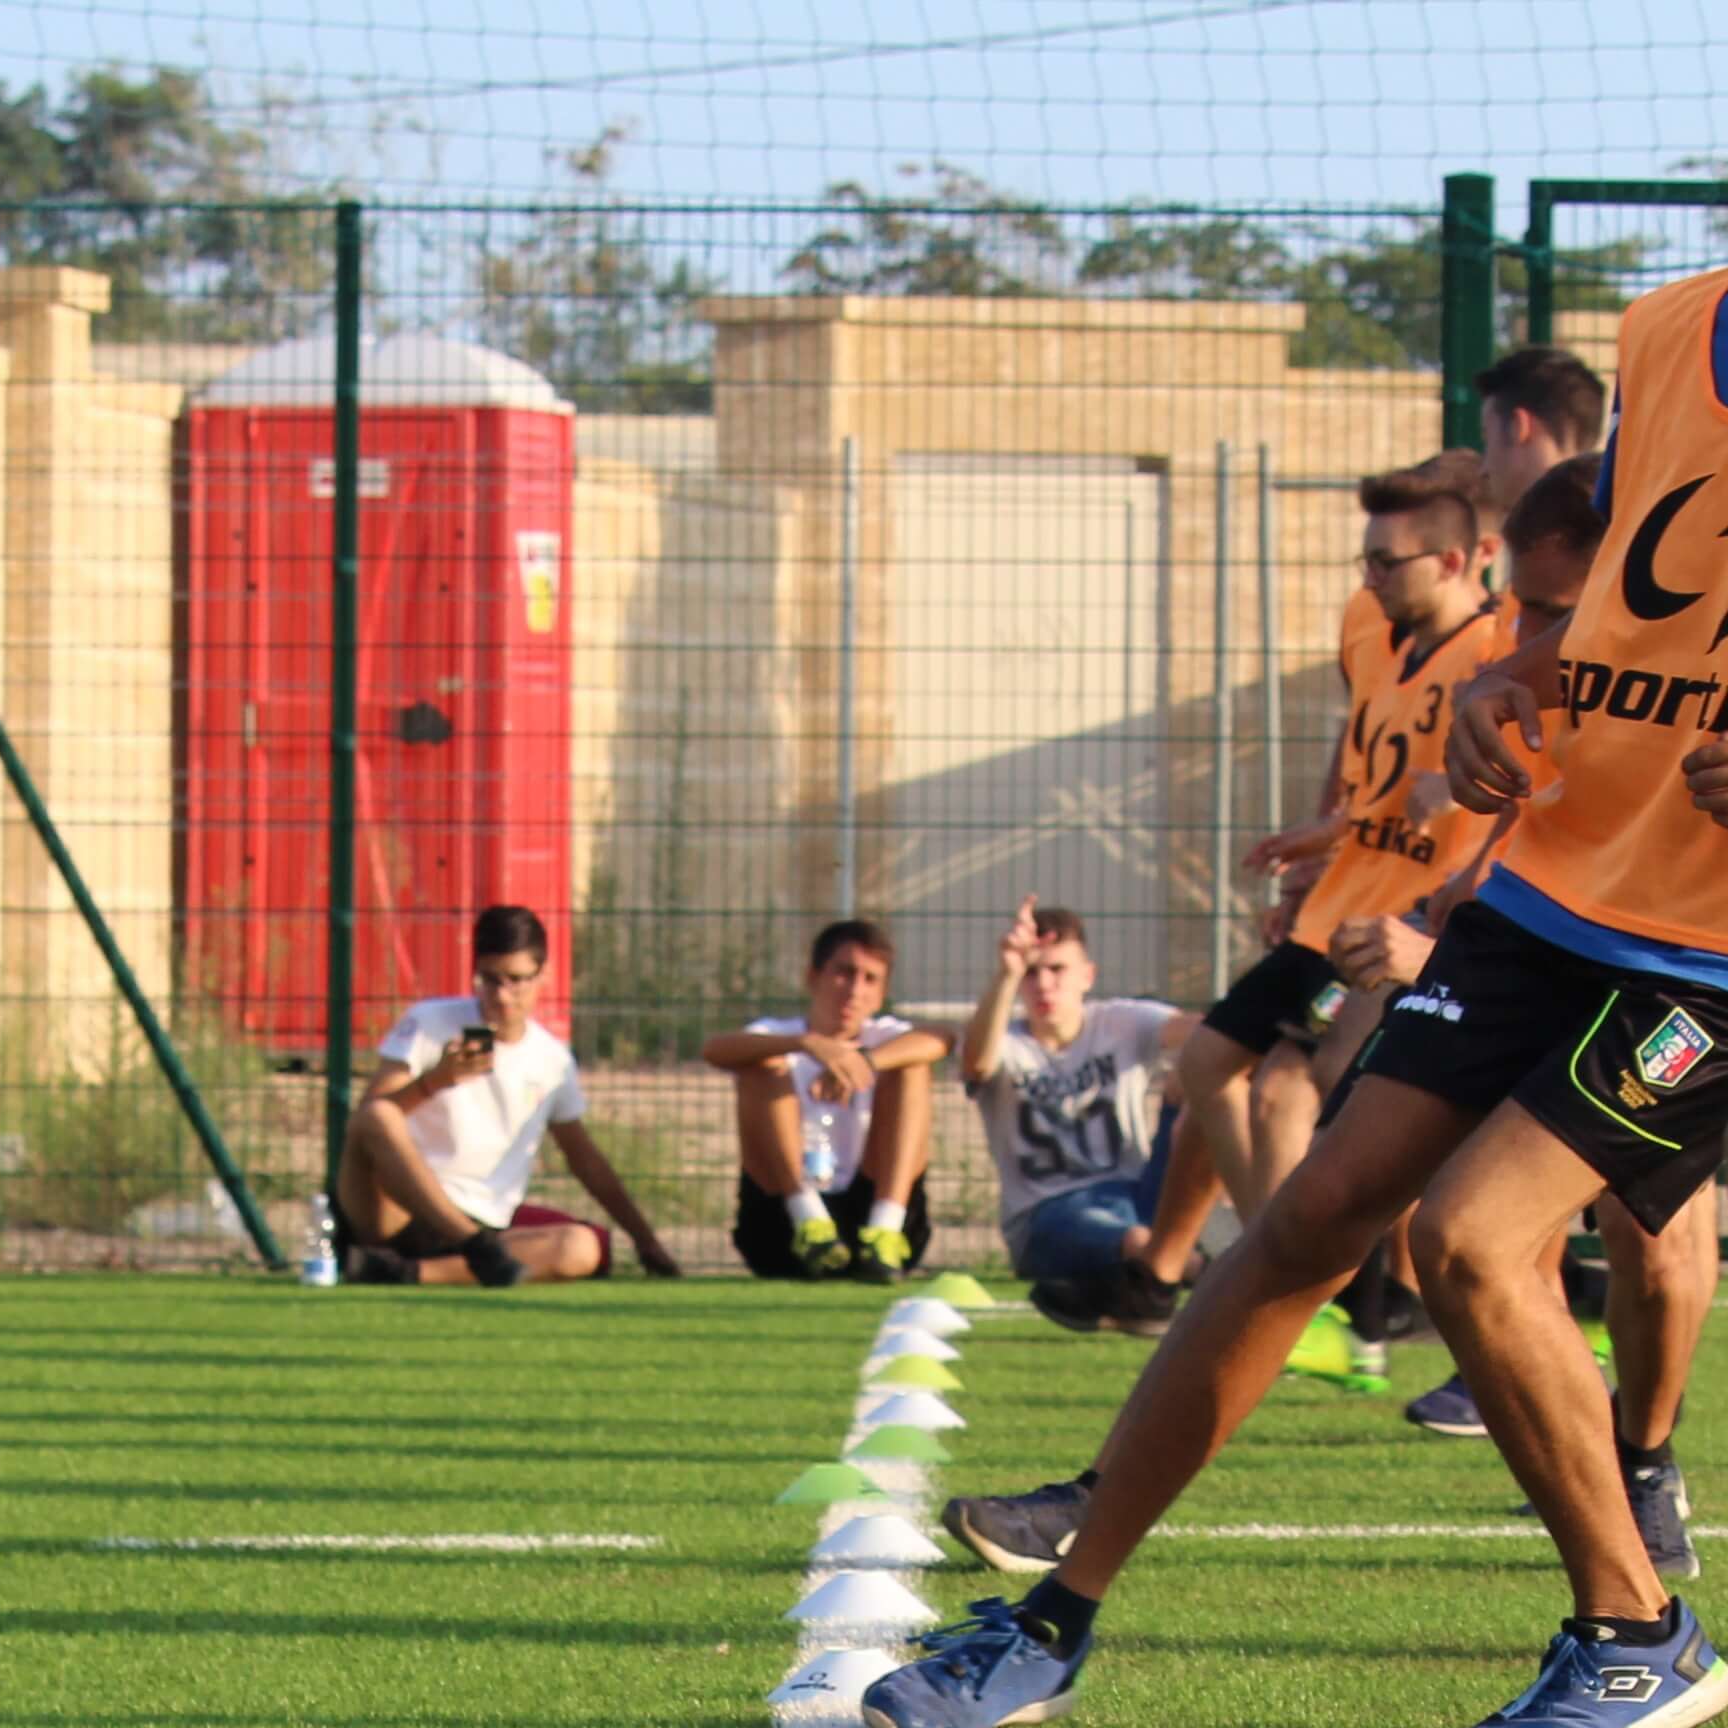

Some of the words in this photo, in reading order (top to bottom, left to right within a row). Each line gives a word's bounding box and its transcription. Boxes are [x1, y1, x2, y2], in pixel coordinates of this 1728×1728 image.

[1415, 682, 1445, 735] 3
[1349, 816, 1437, 866] tika
[1673, 1019, 1702, 1049] ITALIA
